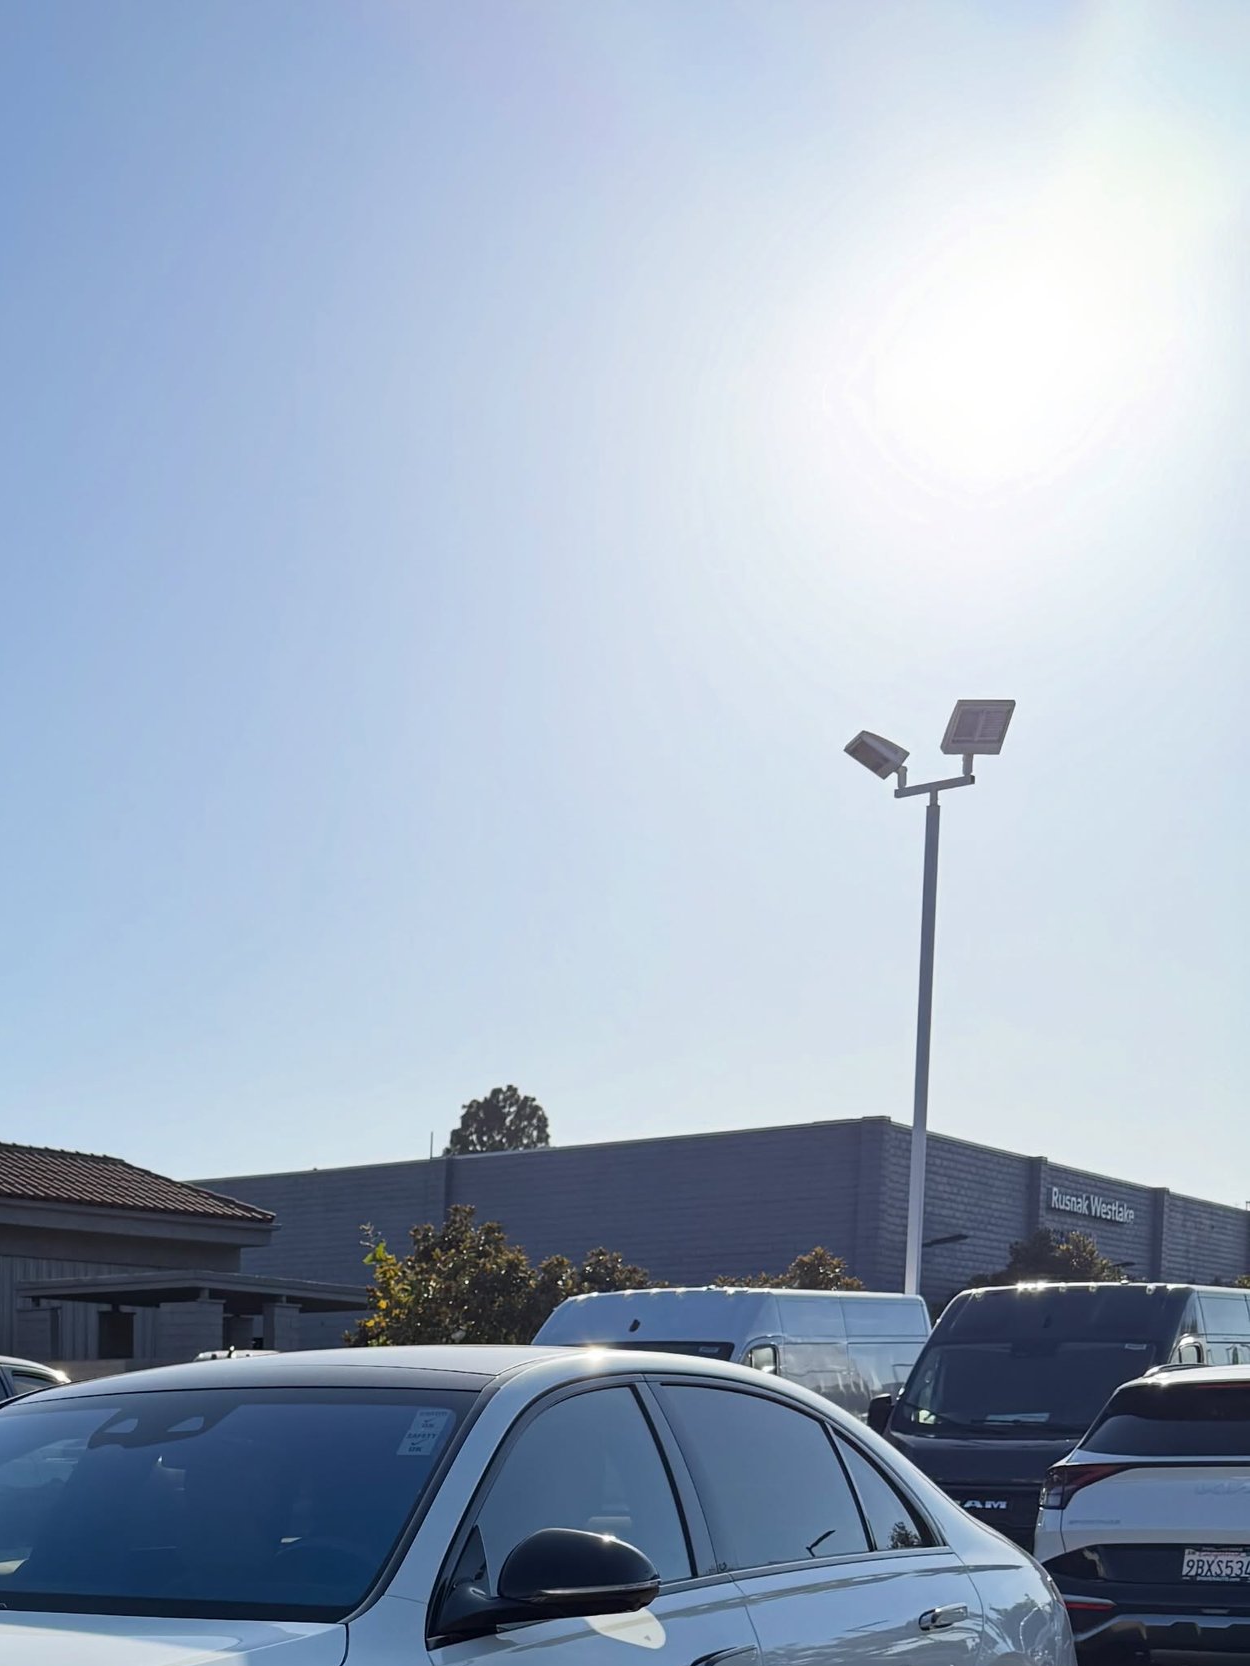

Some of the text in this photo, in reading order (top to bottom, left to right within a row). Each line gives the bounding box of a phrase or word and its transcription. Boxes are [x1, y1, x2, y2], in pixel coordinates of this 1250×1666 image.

[1051, 1187, 1135, 1224] Rusnak Westlake
[954, 1499, 1008, 1509] AM
